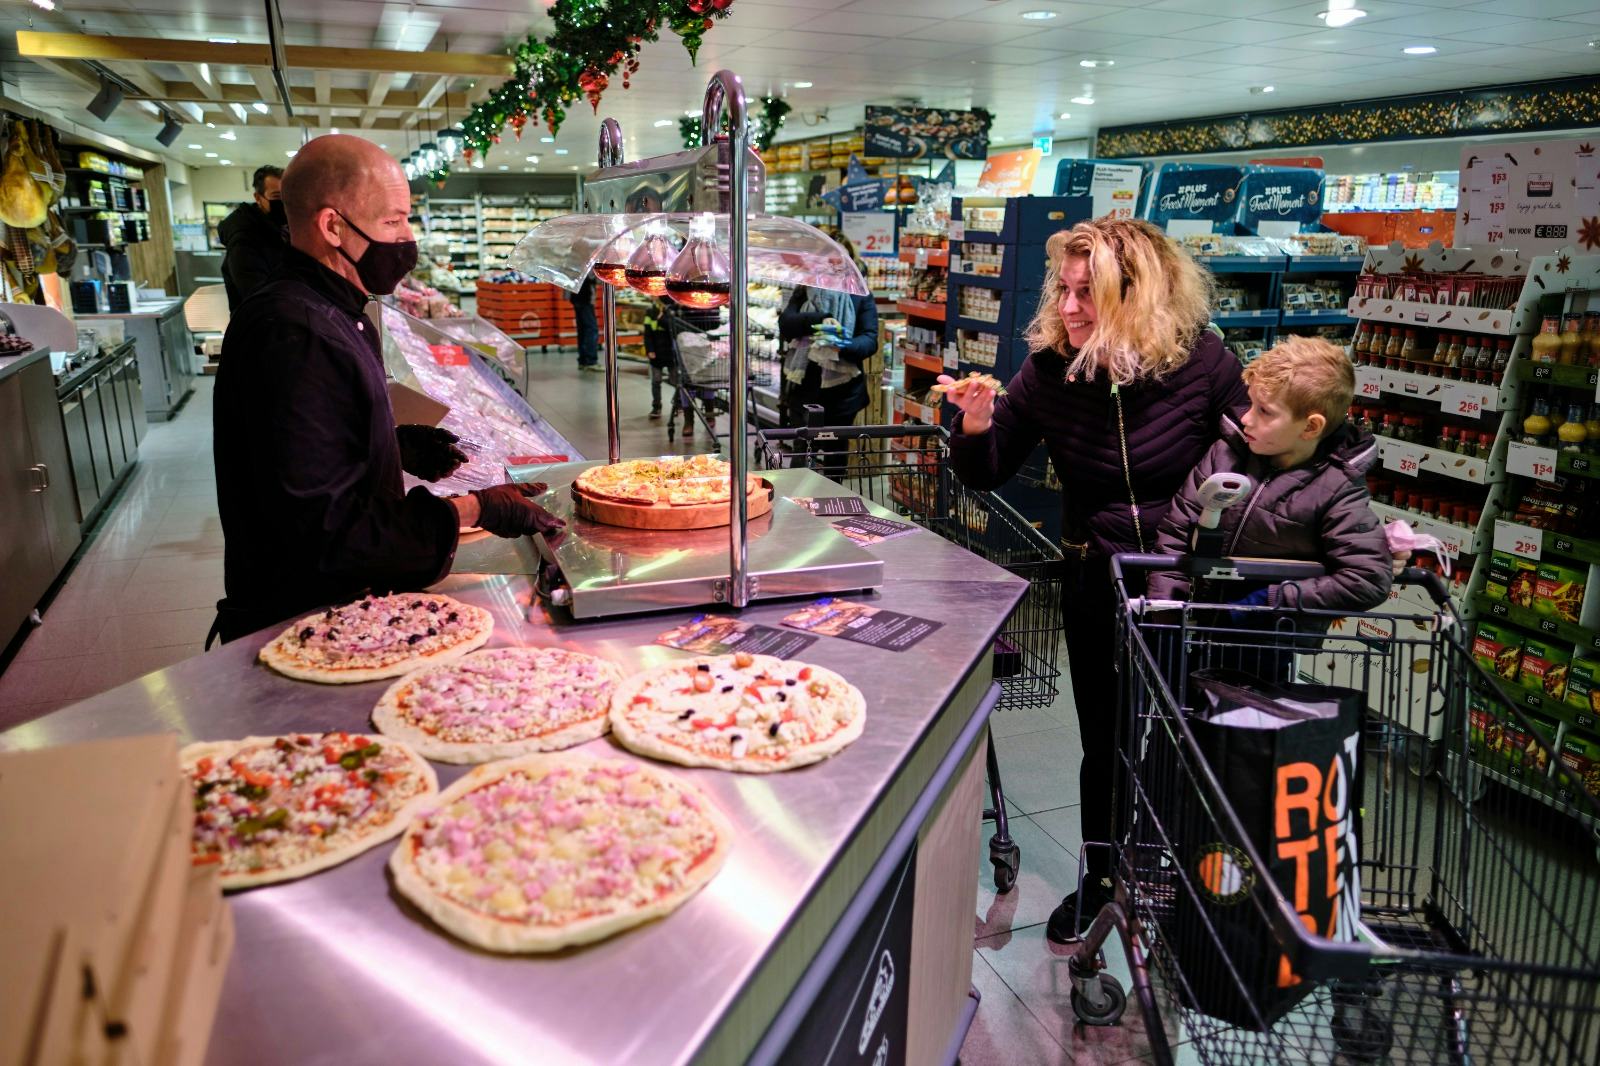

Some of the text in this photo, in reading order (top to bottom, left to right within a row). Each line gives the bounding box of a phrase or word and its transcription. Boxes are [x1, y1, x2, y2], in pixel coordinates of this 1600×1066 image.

[1518, 226, 1532, 235] VOOR
[1532, 463, 1553, 475] 1.54
[1514, 540, 1538, 553] 2.99
[1359, 618, 1389, 637] Verstegen
